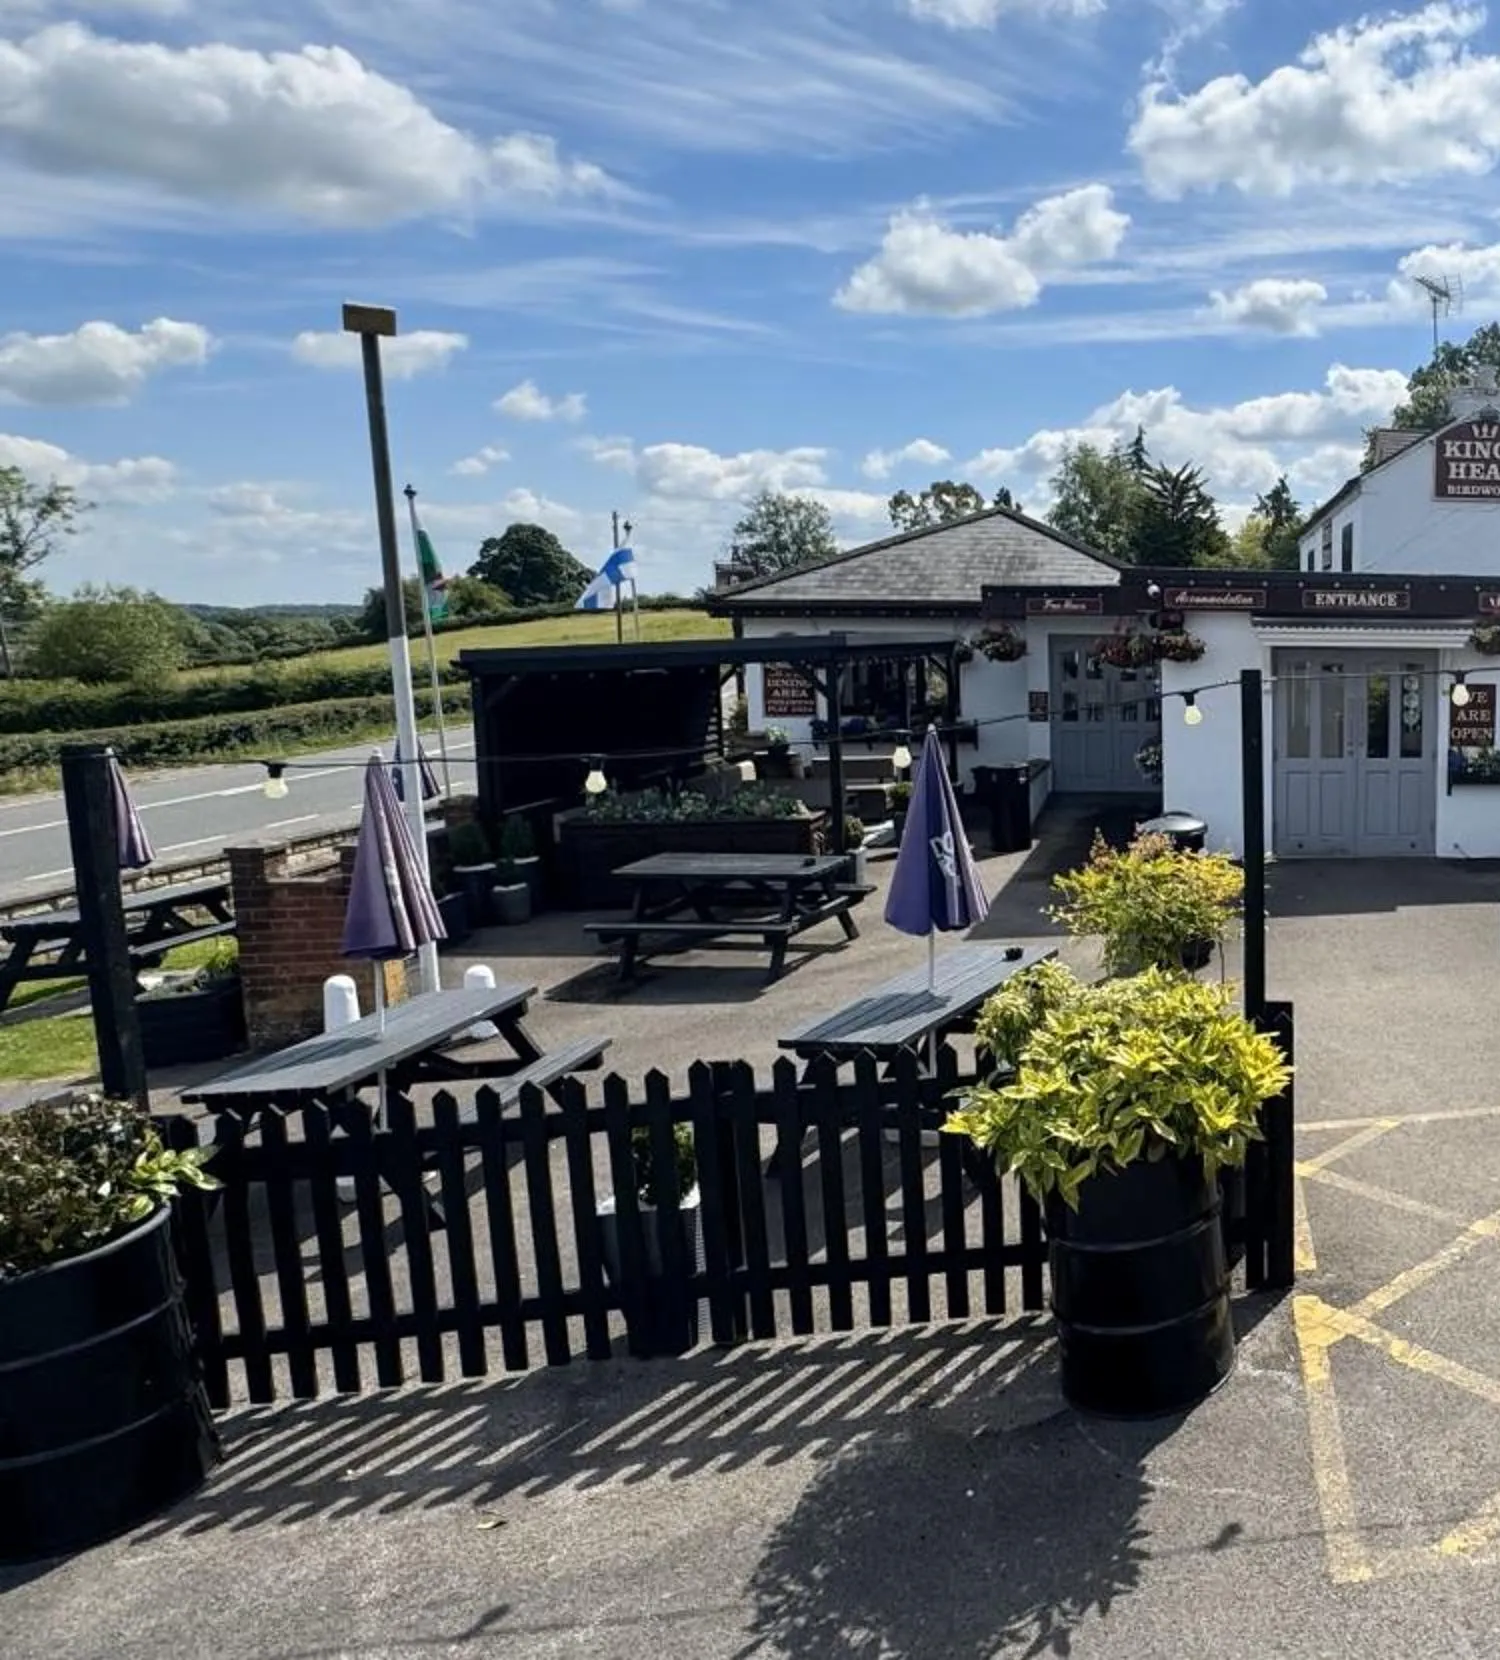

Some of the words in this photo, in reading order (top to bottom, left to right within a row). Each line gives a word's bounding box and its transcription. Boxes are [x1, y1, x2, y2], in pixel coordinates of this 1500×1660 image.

[1314, 593, 1398, 607] ENTRANCE
[771, 688, 809, 698] AREA
[1456, 709, 1491, 723] ARE
[1451, 727, 1493, 740] OPEN
